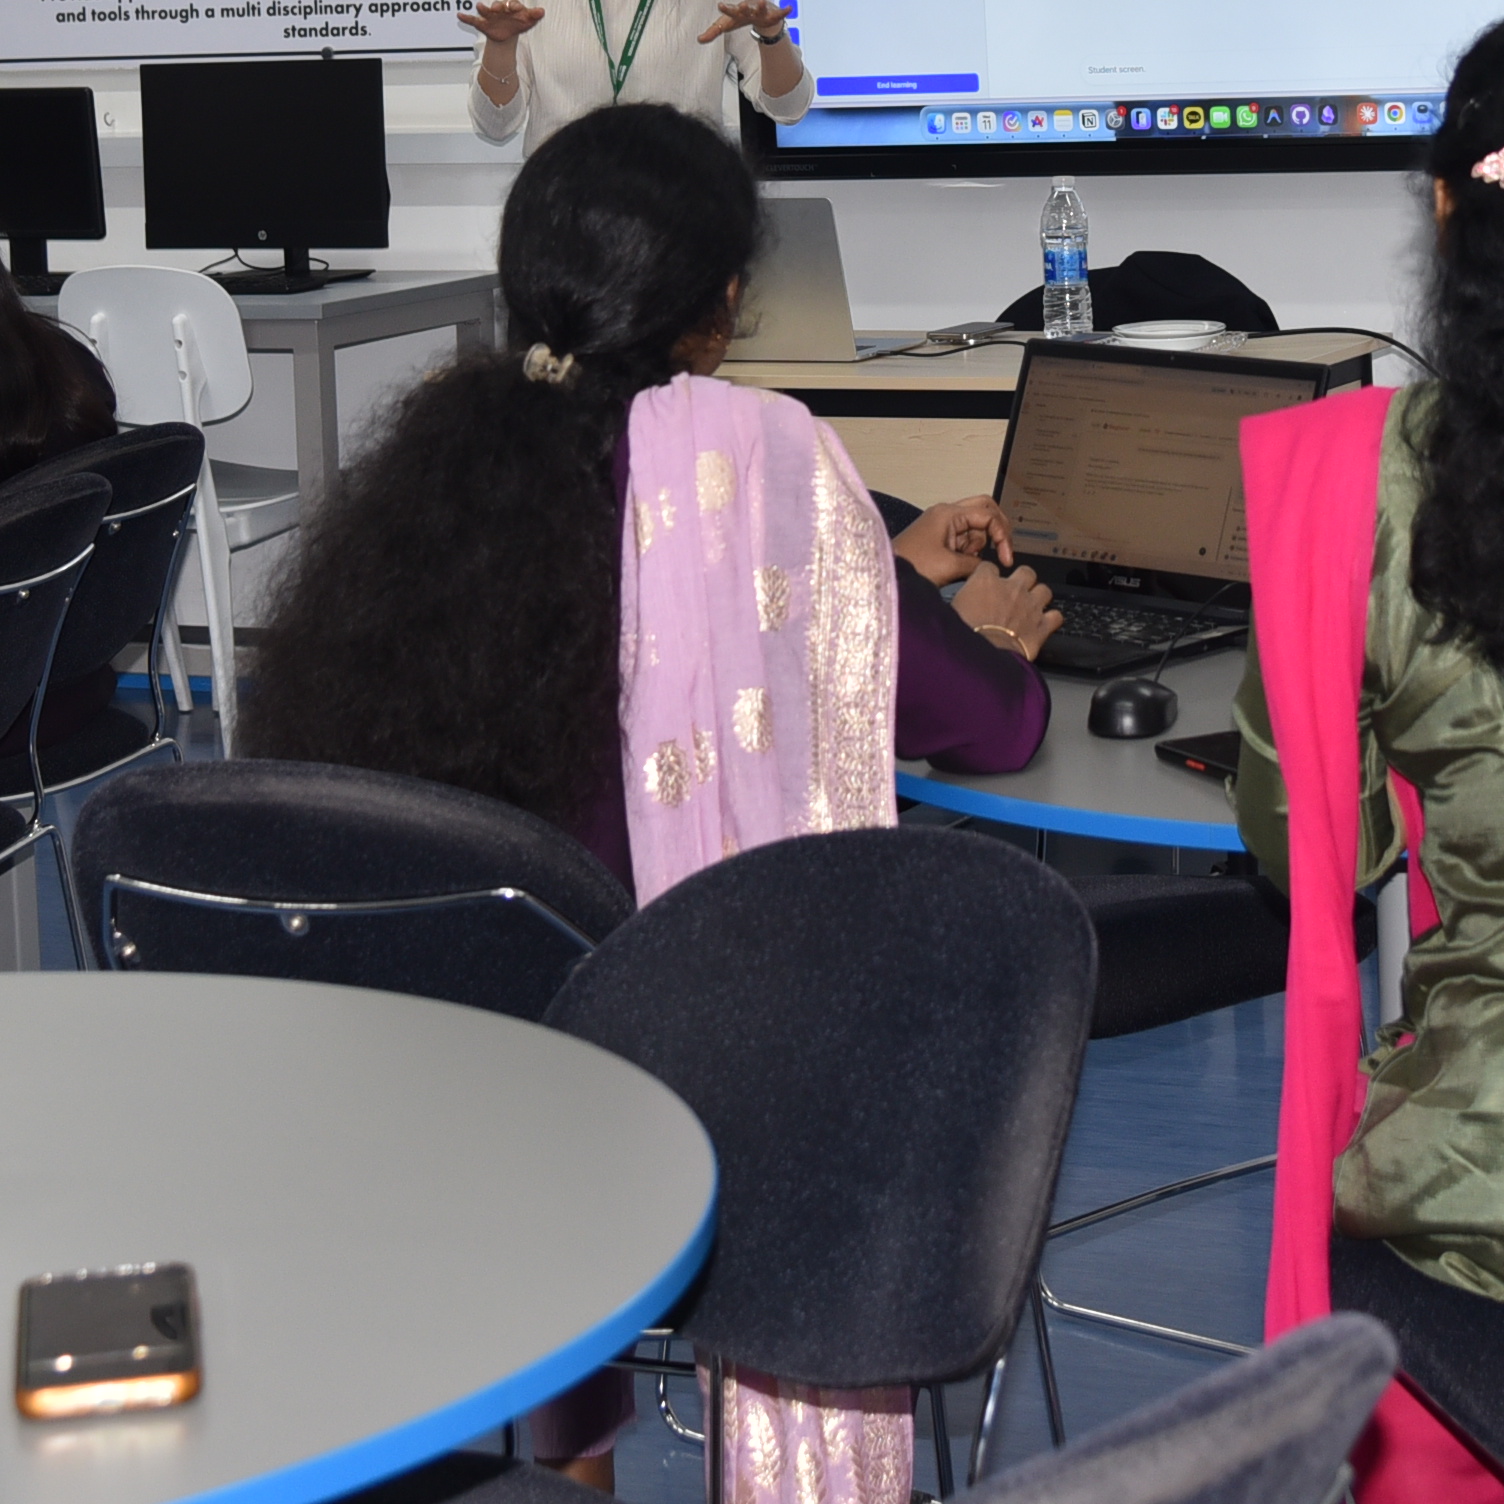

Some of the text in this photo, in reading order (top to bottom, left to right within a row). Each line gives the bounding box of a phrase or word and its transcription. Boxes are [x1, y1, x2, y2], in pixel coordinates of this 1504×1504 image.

[56, 6, 86, 23] and
[91, 6, 132, 22] tools
[134, 3, 199, 24] through
[205, 8, 215, 19] a
[220, 2, 261, 18] multi
[266, 0, 363, 23] disciplinary
[283, 17, 371, 39] standards.
